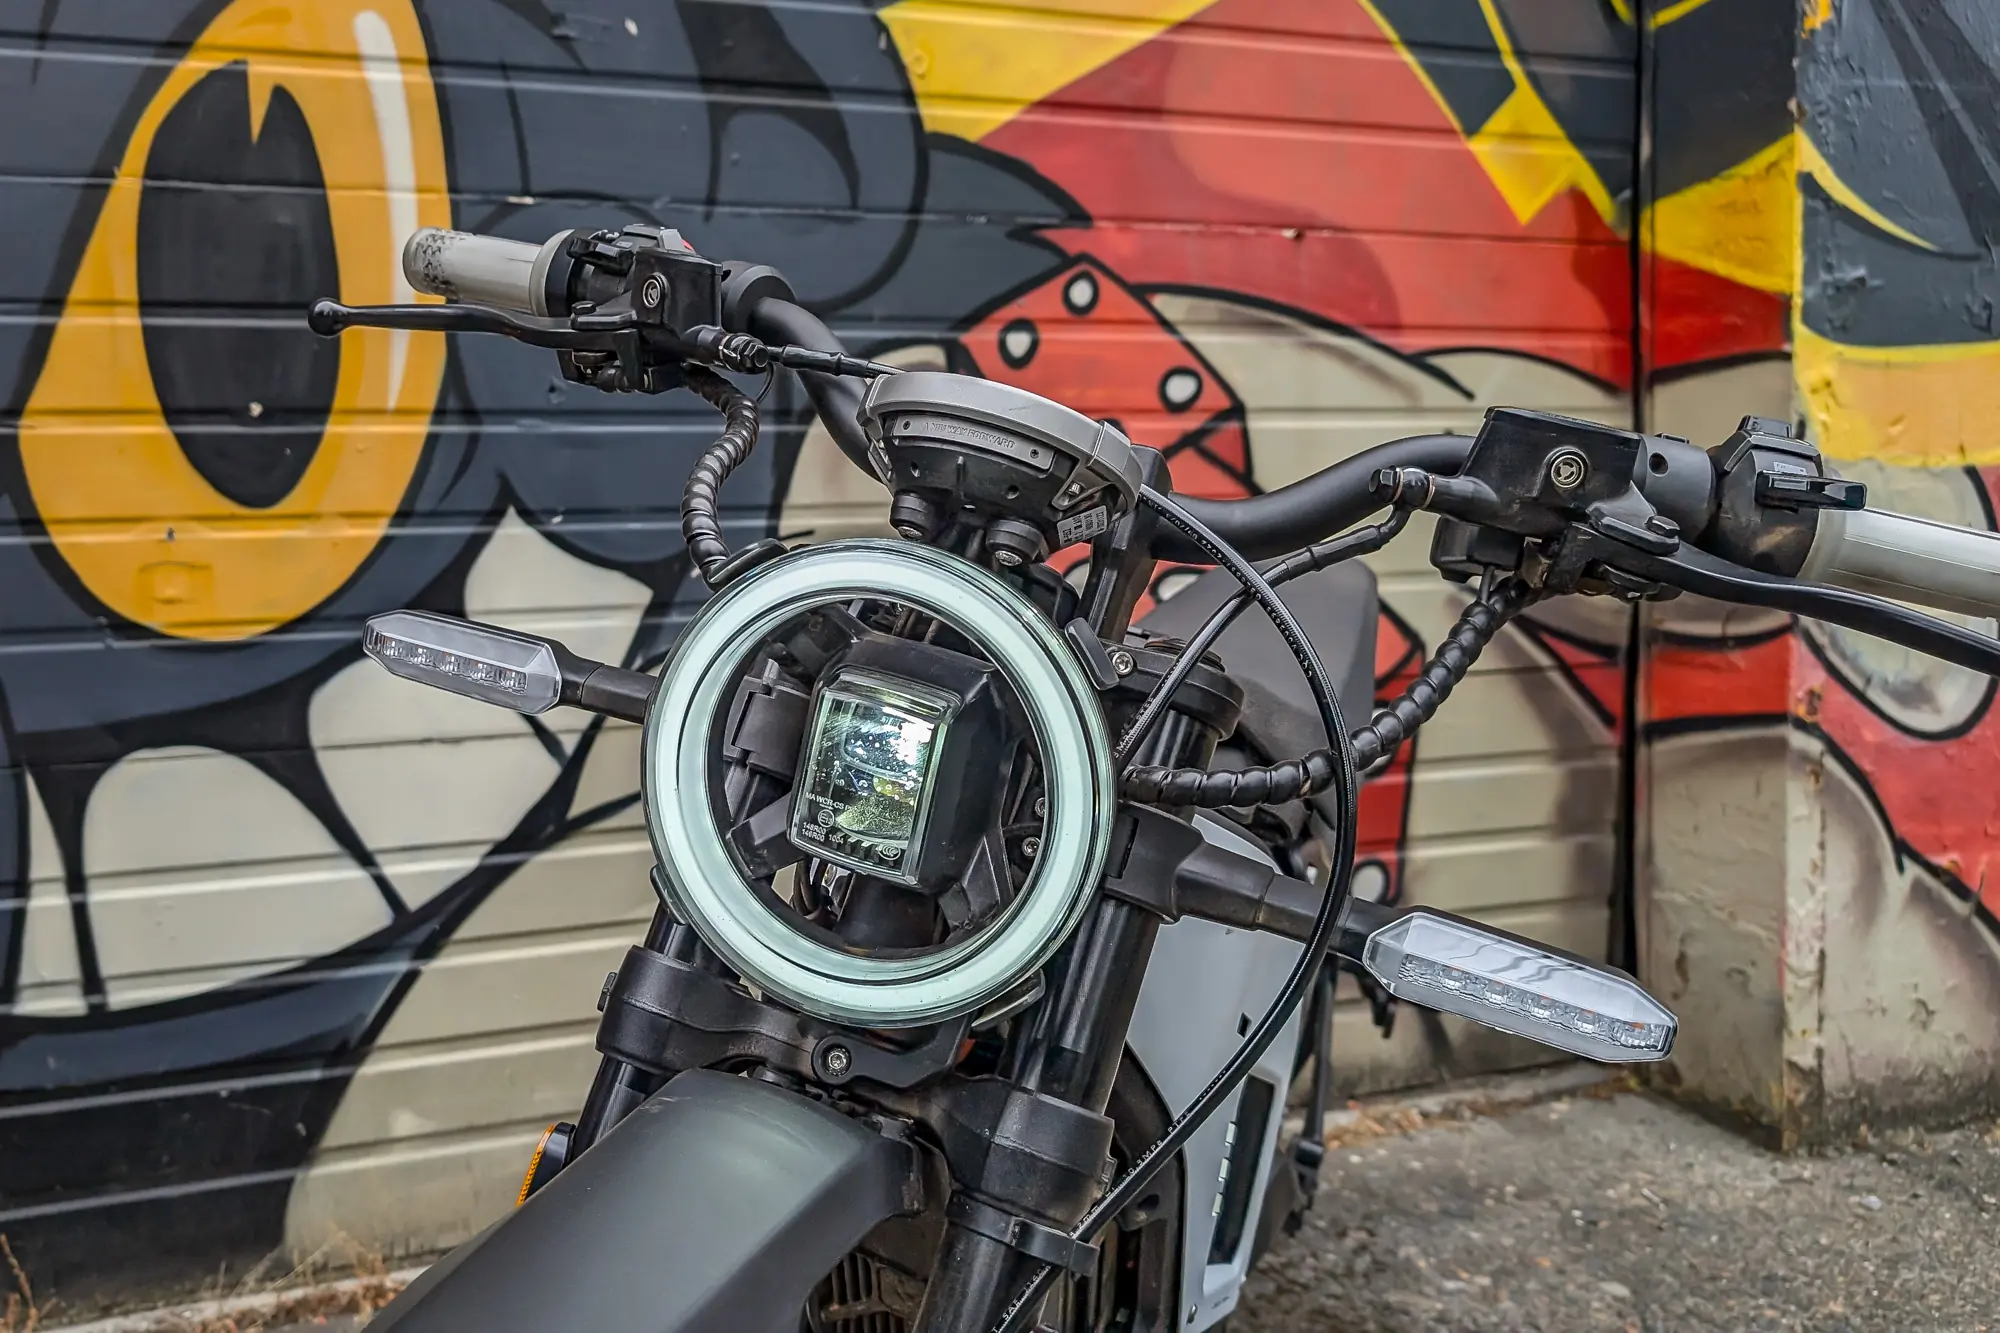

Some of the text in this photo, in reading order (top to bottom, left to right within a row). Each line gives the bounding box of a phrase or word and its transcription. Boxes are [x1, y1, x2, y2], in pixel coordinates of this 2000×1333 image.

[924, 422, 929, 431] A
[947, 424, 967, 436] WAY
[968, 429, 1016, 449] FORWARD
[805, 792, 816, 801] MA
[816, 796, 844, 810] WCR-CS
